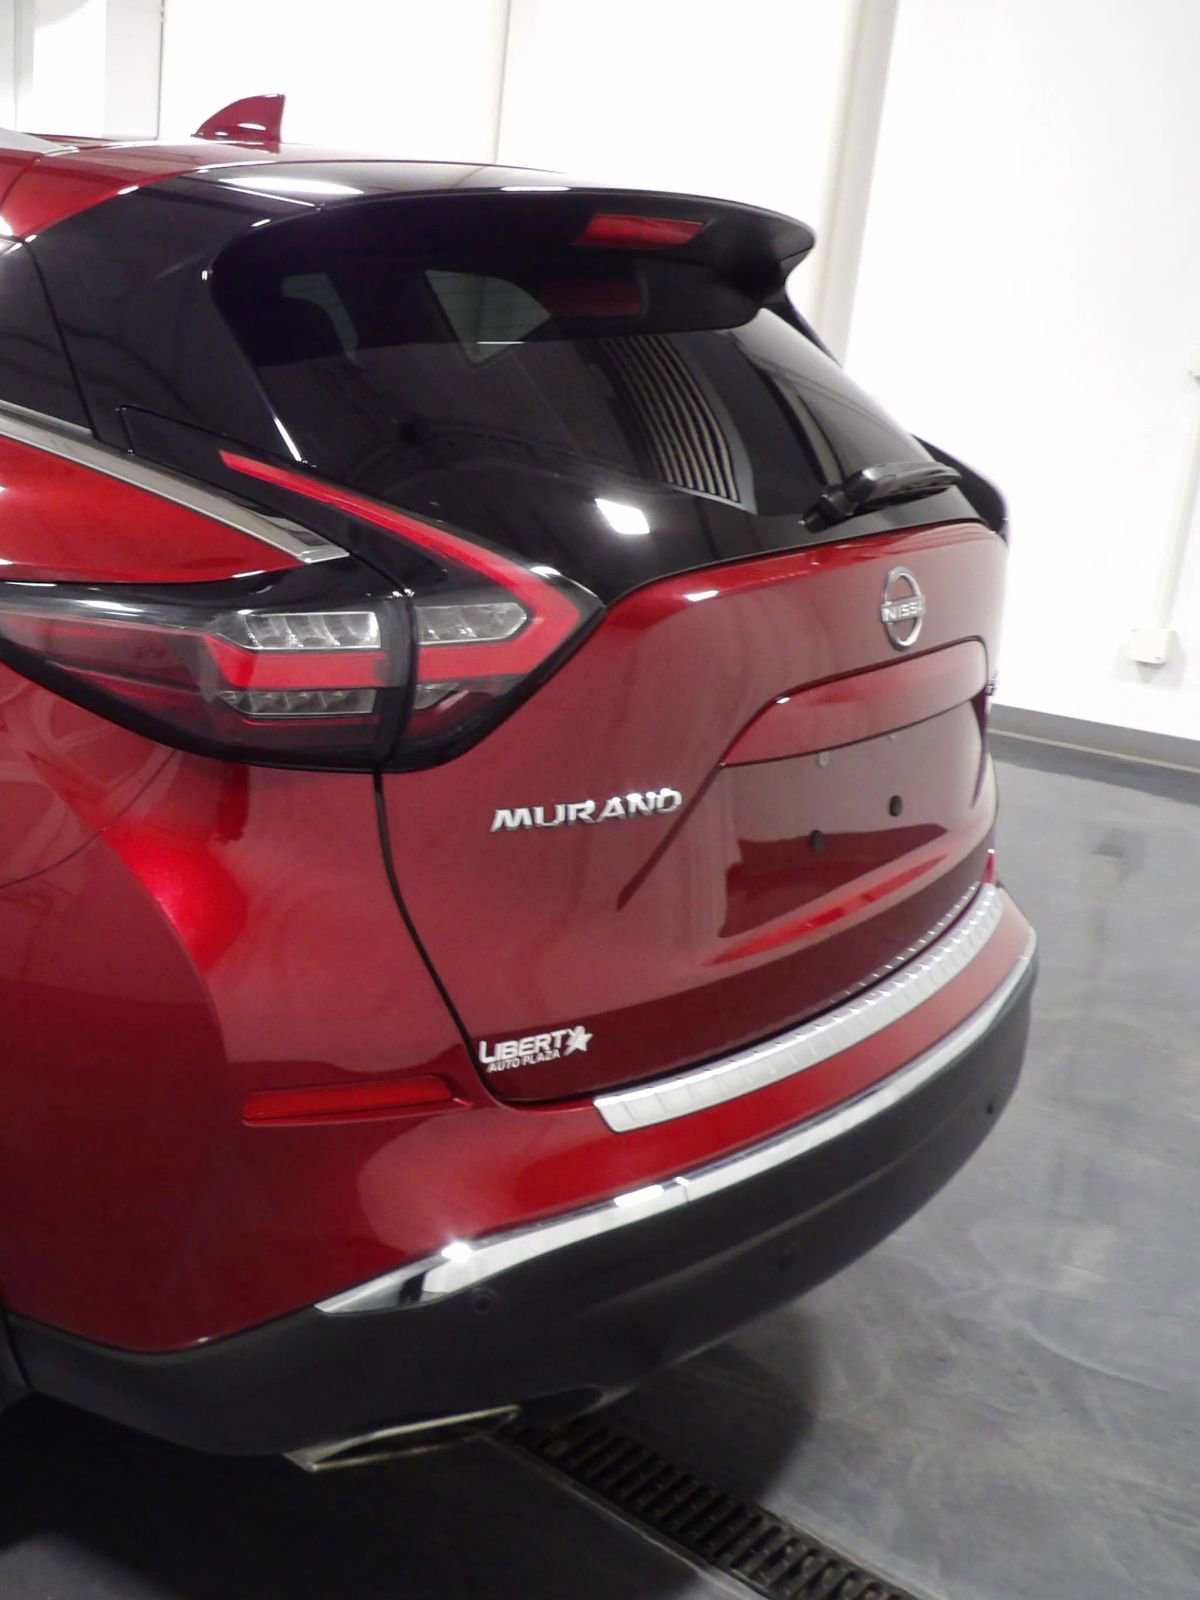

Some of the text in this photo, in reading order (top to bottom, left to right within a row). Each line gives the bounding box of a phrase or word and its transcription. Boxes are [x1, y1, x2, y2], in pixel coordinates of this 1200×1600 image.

[882, 599, 925, 621] NISS
[490, 787, 682, 832] MURANO
[486, 1049, 561, 1073] AUTO PLAZA
